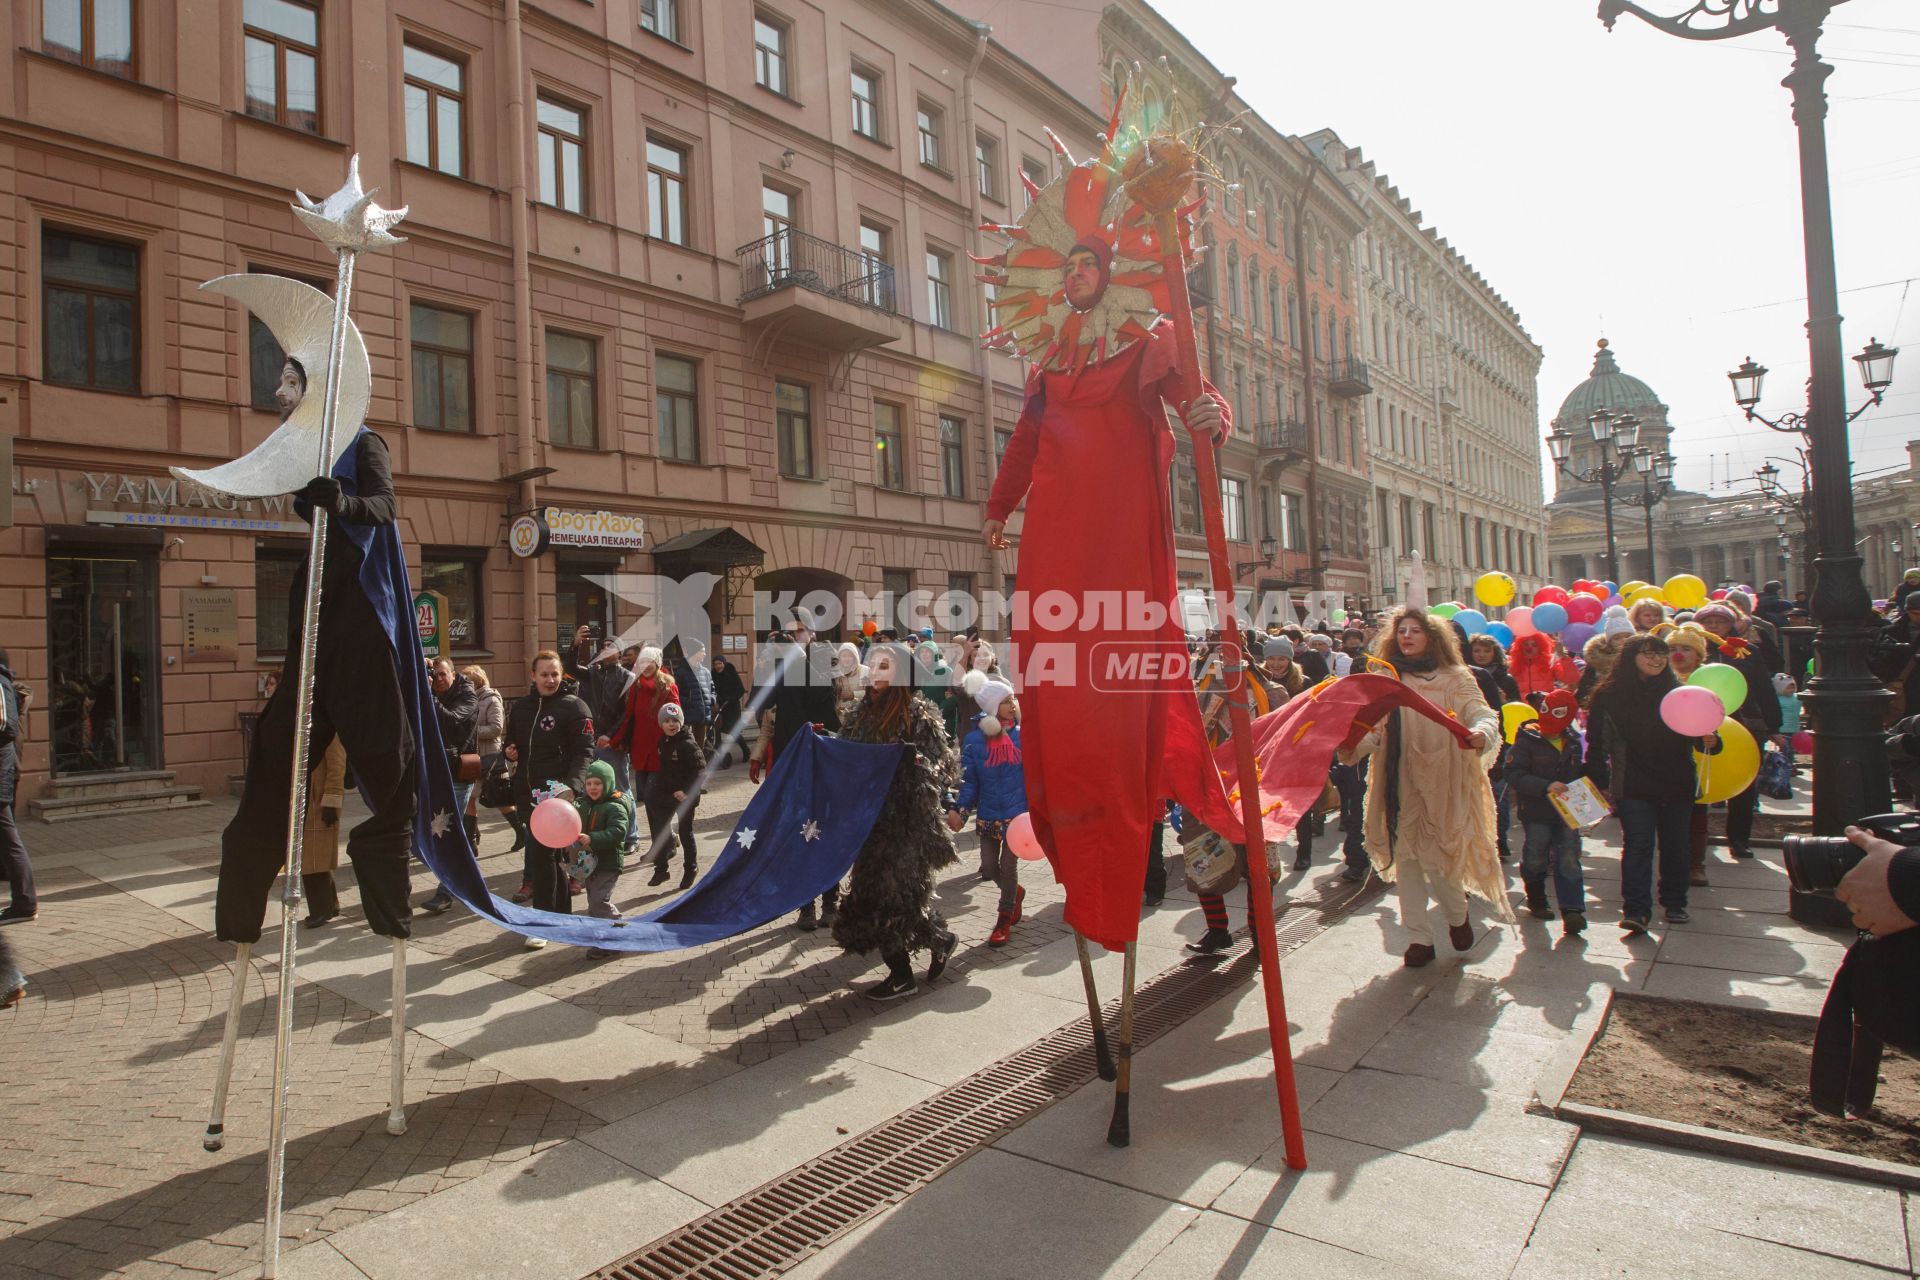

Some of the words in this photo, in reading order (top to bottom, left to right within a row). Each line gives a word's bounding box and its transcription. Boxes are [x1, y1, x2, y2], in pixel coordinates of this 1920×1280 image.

[82, 472, 297, 514] YAMAGW
[549, 533, 599, 545] НЕМЕЦКАЯ
[601, 535, 642, 547] ПЕКАРНЯ
[417, 605, 433, 626] 24
